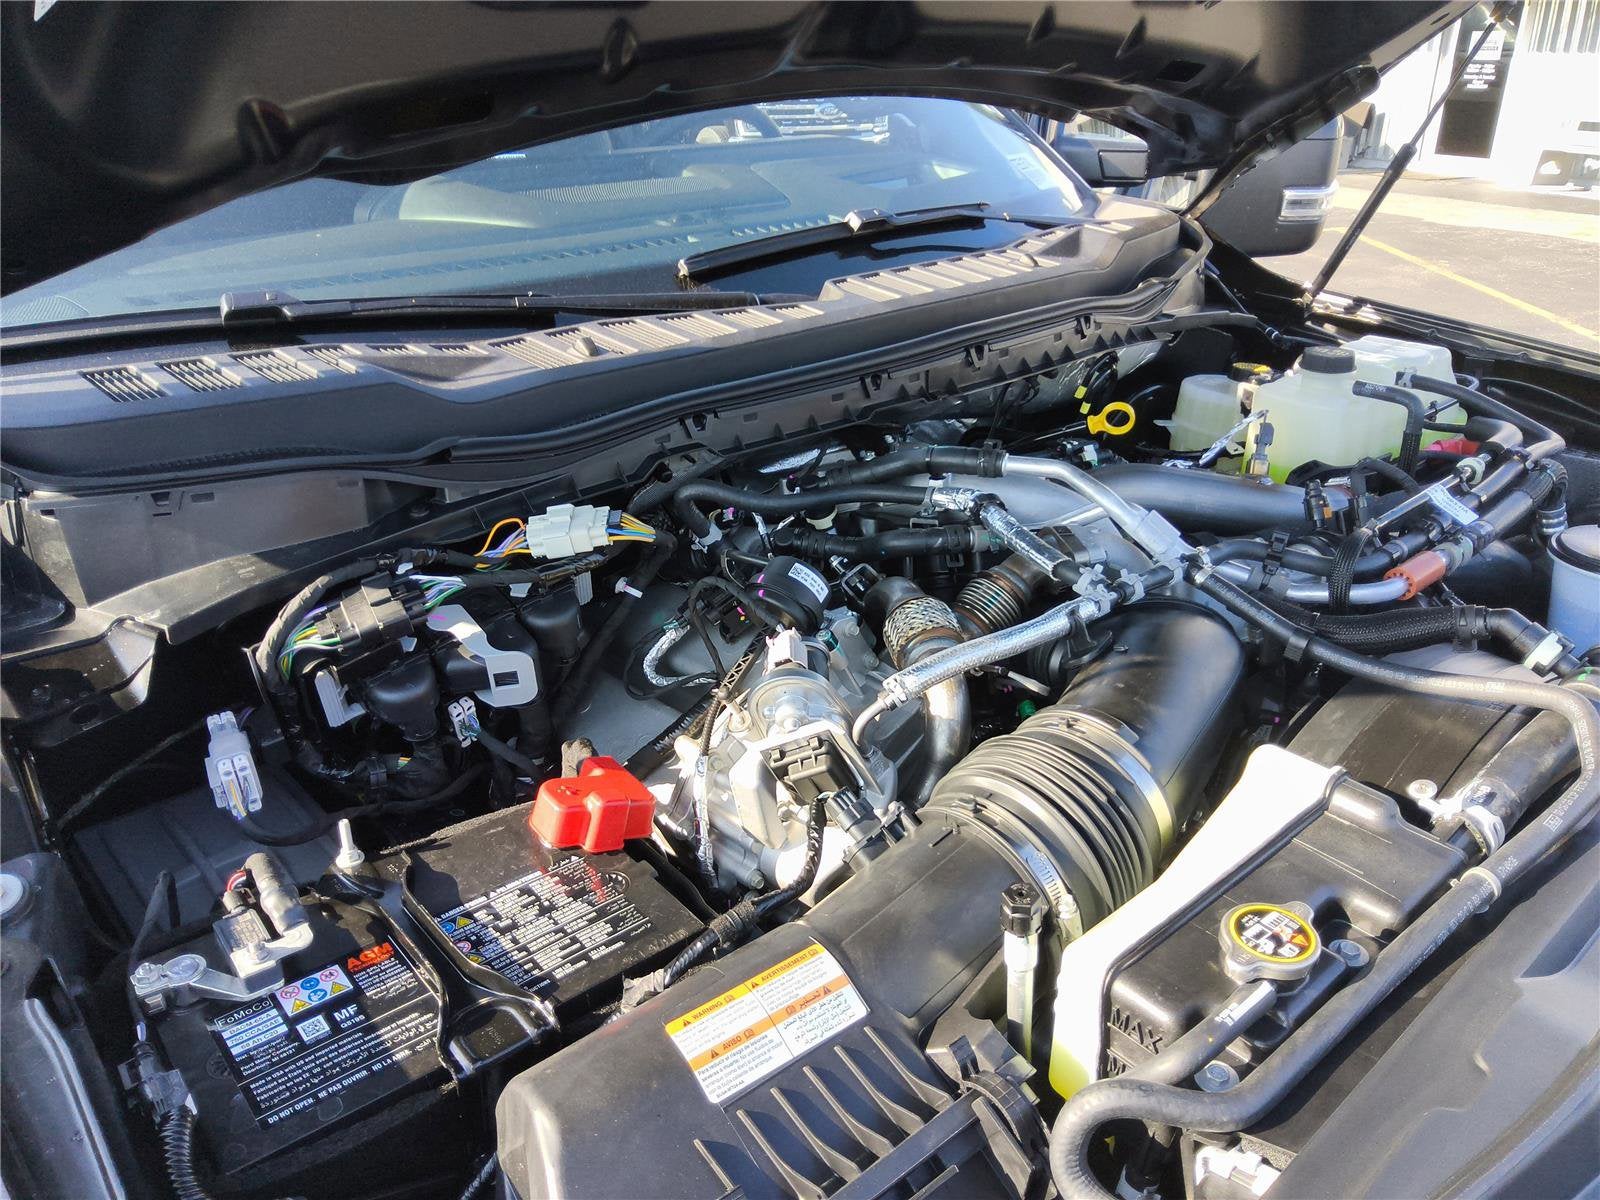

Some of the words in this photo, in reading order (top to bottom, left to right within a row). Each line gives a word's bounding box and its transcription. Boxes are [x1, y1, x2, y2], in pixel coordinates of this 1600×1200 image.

[347, 942, 392, 968] AGM
[761, 953, 807, 981] AVERTISSEMENT
[217, 1000, 269, 1028] FoMoCo
[333, 1004, 357, 1021] MF
[691, 1000, 722, 1019] WARNING
[1111, 1007, 1163, 1055] MAX
[314, 1043, 338, 1056] imported
[722, 1035, 741, 1050] AVISO
[294, 1097, 315, 1110] OPEN.
